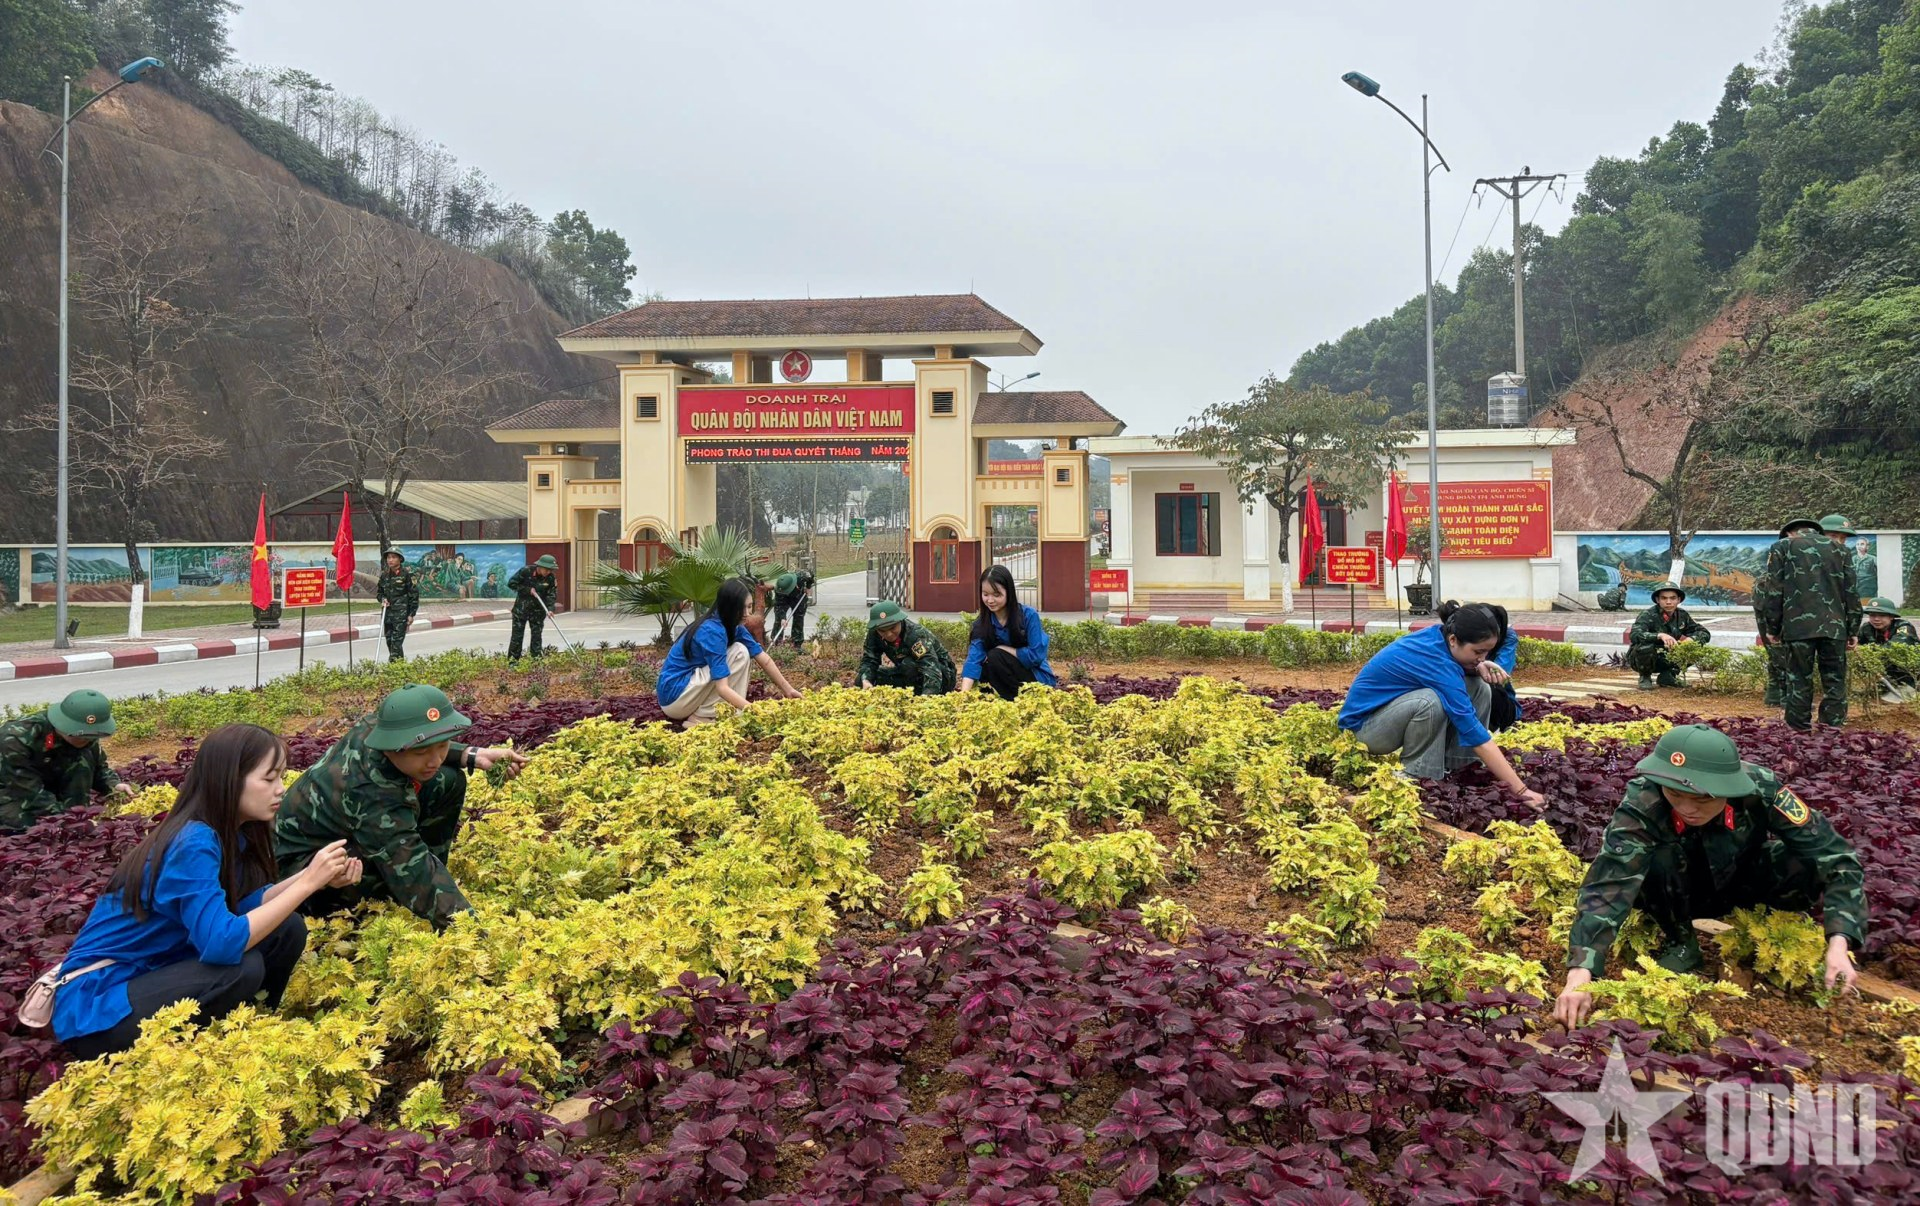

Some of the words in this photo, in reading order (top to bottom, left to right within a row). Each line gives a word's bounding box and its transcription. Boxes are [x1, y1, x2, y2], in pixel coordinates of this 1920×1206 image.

[746, 395, 807, 404] DOANH
[812, 394, 846, 405] TRẠI
[691, 408, 729, 430] QUÂN
[733, 408, 756, 432] ĐỘI
[760, 408, 799, 428] NHÂN
[803, 407, 832, 428] DÂN
[836, 407, 865, 431] VIỆT
[869, 409, 903, 427] NAM
[691, 448, 724, 457] PHONG
[726, 446, 752, 456] TRÀO
[755, 448, 769, 456] THI
[871, 445, 892, 456] NĂM
[1402, 504, 1424, 514] UYẾT
[1446, 504, 1470, 513] HOÀN
[1472, 504, 1500, 513] THÀNH
[1502, 502, 1524, 512] XUẤT
[1526, 502, 1544, 512] SẮC
[1456, 515, 1472, 524] XÂY
[1474, 515, 1498, 525] DỰNG
[1475, 526, 1497, 534] TOÀN
[1499, 525, 1520, 535] DIỆN
[1473, 536, 1491, 545] TIÊU
